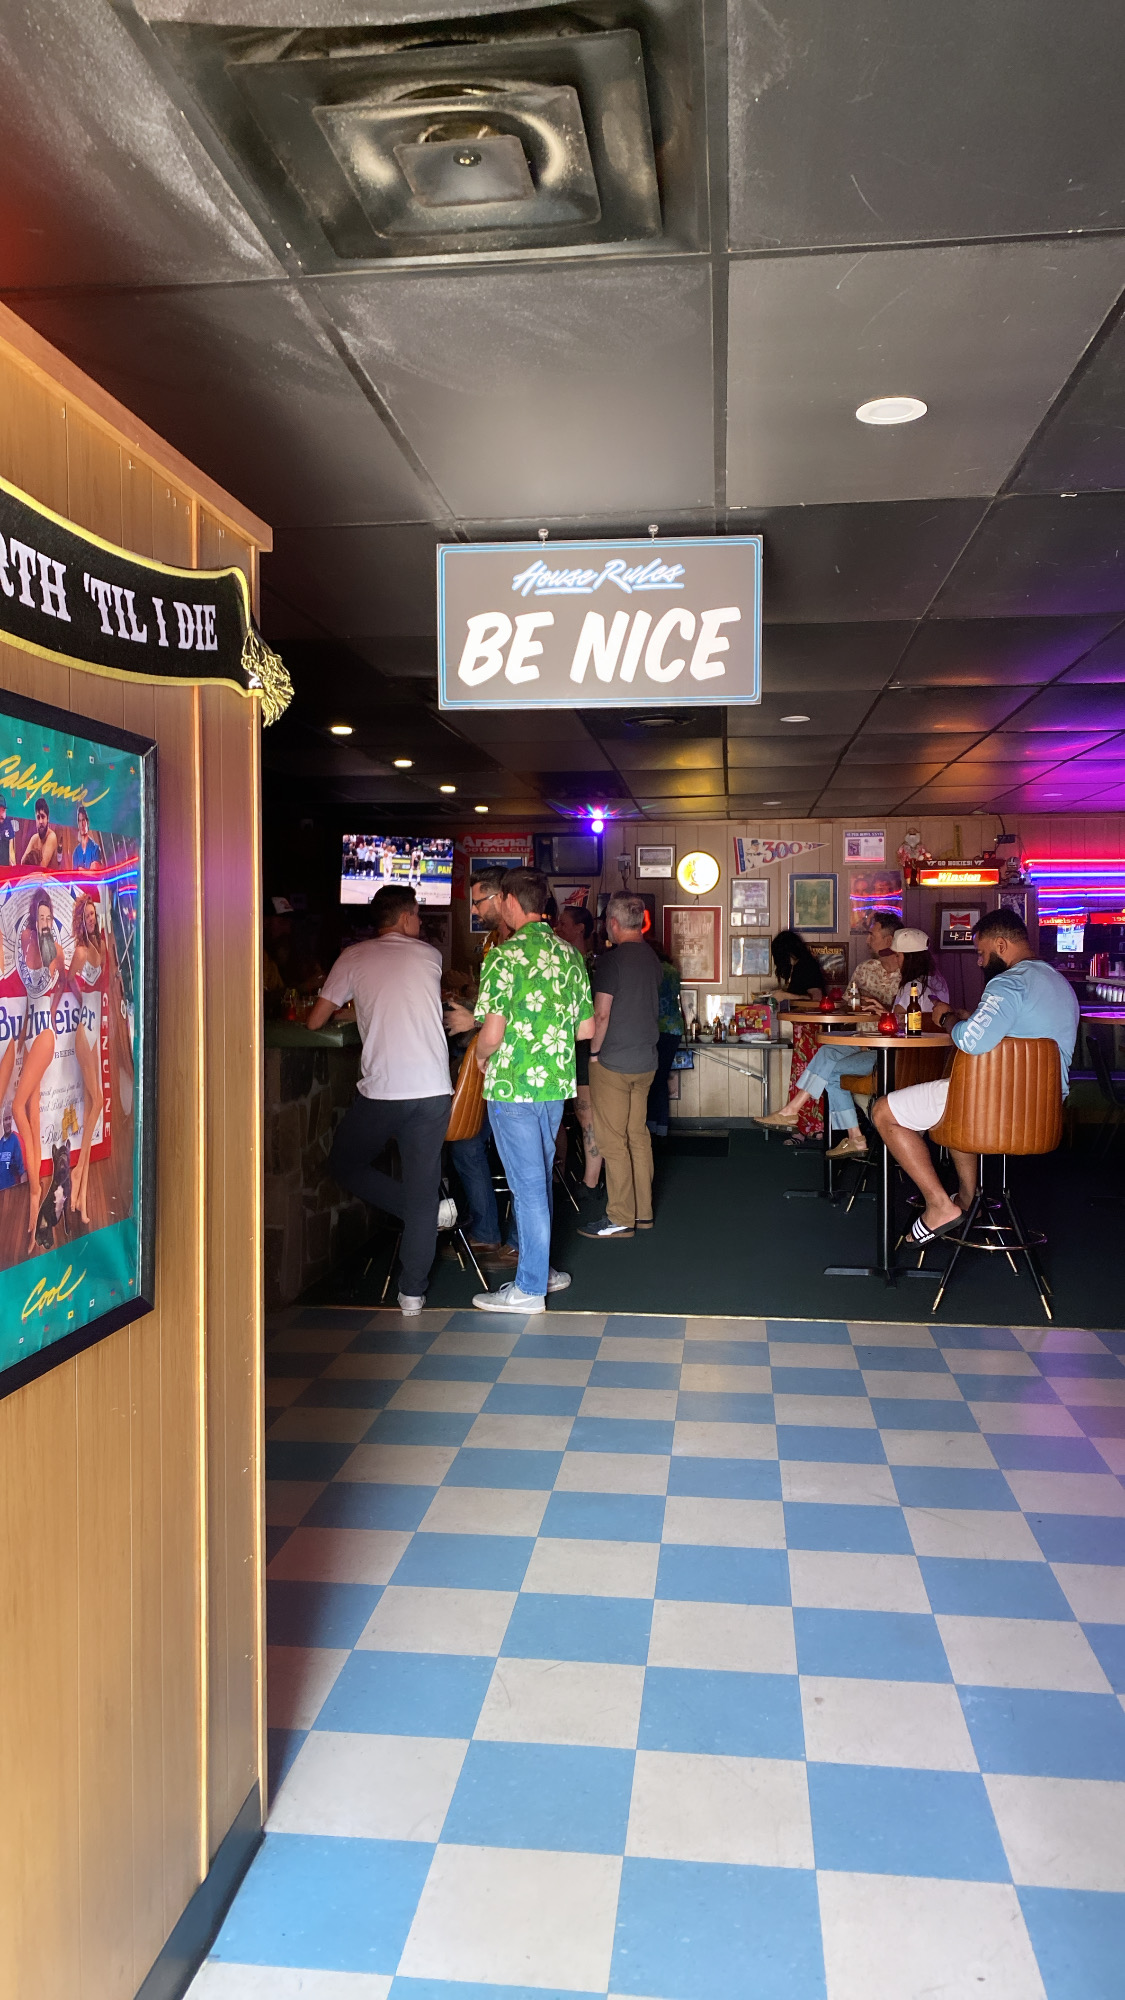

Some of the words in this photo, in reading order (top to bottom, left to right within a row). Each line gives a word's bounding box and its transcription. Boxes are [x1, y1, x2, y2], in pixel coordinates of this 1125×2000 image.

[512, 559, 599, 597] House
[592, 557, 686, 594] Rules
[84, 573, 147, 643] 'TIL
[152, 597, 169, 647] I
[173, 601, 218, 651] DIE
[458, 611, 555, 687] BE
[569, 606, 742, 684] NICE
[0, 754, 110, 807] California
[463, 835, 533, 848] Arsenal
[762, 841, 803, 863] 300
[938, 872, 982, 882] Winston
[810, 945, 844, 955] weiser
[0, 1000, 96, 1042] Budweiser
[963, 995, 1004, 1052] COSTA
[22, 1264, 88, 1320] Cool
